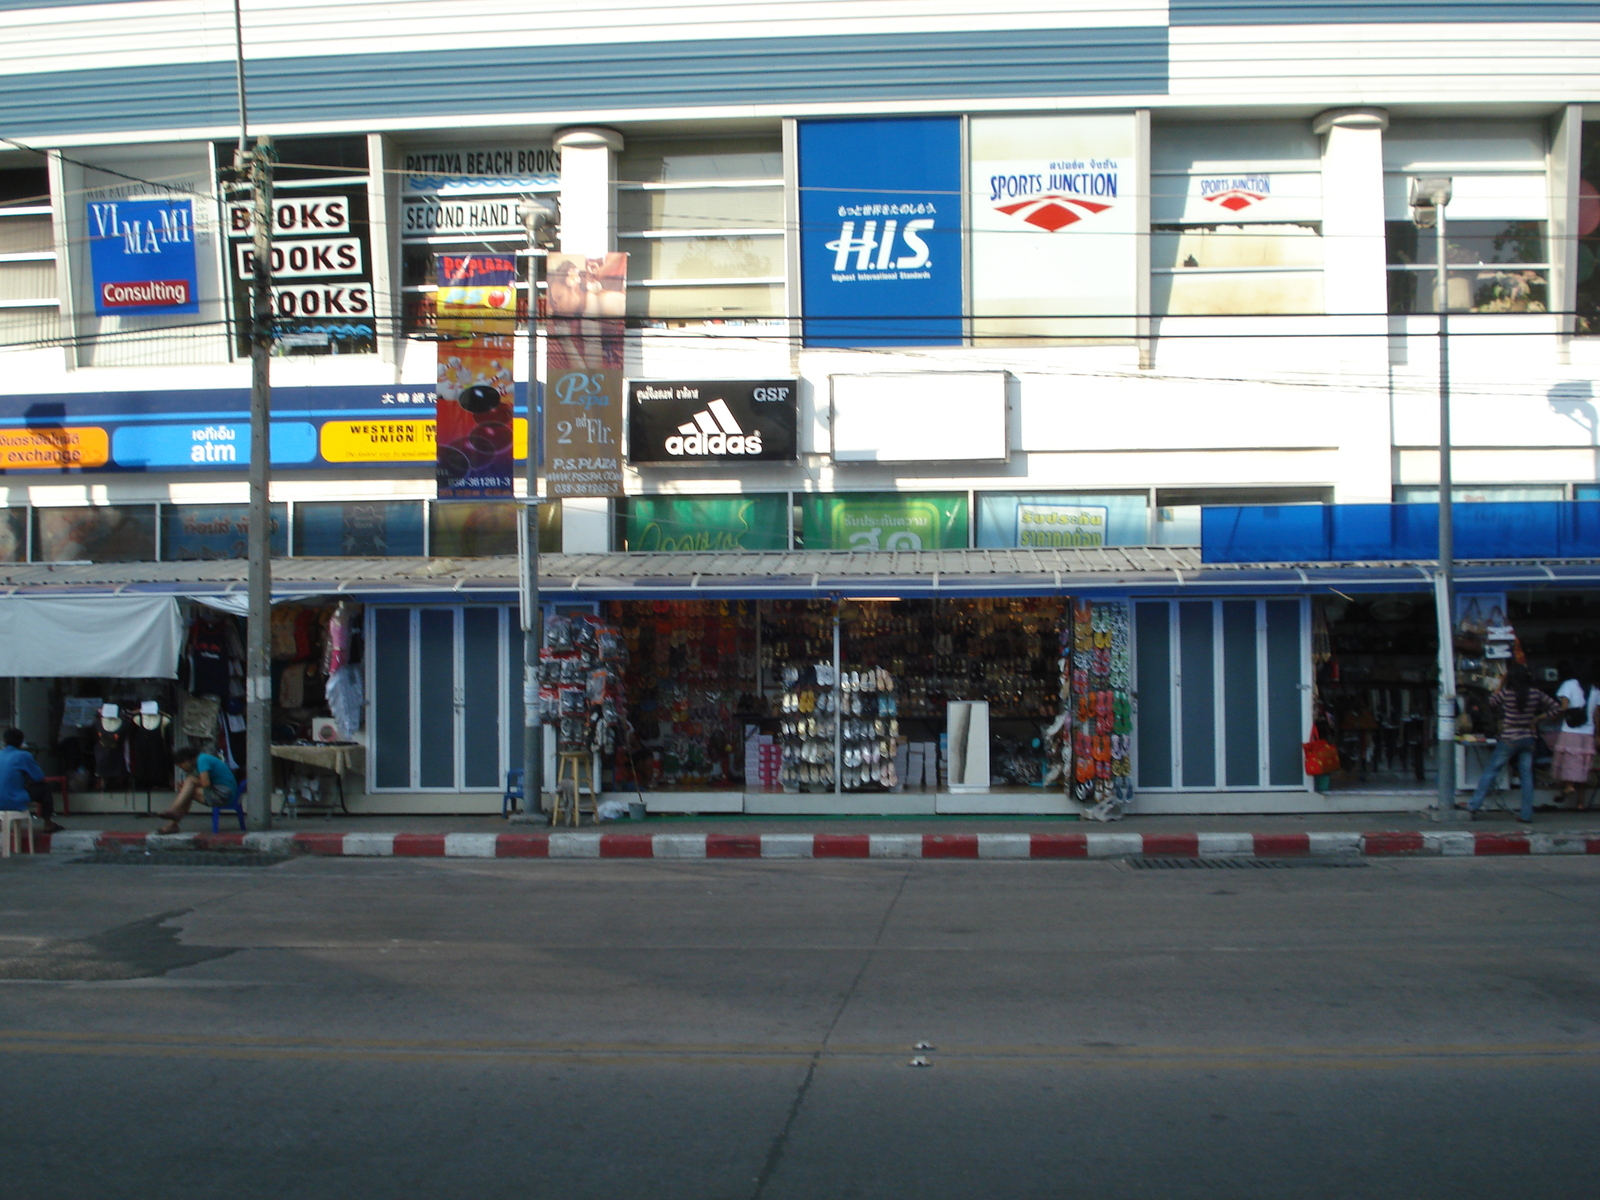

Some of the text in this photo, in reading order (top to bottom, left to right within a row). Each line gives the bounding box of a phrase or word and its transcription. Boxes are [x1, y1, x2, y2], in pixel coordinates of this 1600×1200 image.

[406, 153, 462, 177] PATTAYA
[467, 151, 513, 175] BEACH
[990, 173, 1118, 201] SPORTS JUNCTION
[1201, 178, 1271, 196] SPORTS JUNCTION
[231, 202, 346, 231] BOKS
[406, 204, 464, 230] SECOND
[470, 203, 509, 227] HAND
[91, 203, 192, 254] VI MA MI
[858, 271, 898, 281] International
[899, 270, 931, 280] Standards
[103, 281, 187, 305] Consulting
[270, 288, 369, 317] OOKS
[753, 387, 790, 402] GSF
[350, 424, 414, 434] WESTERN
[370, 434, 414, 443] UNION
[191, 441, 236, 463] atm
[665, 430, 763, 455] adidas
[8, 449, 81, 465] exchange
[1022, 510, 1102, 526] รับประกัน
[1020, 526, 1103, 548] ราคาถกด้วย
